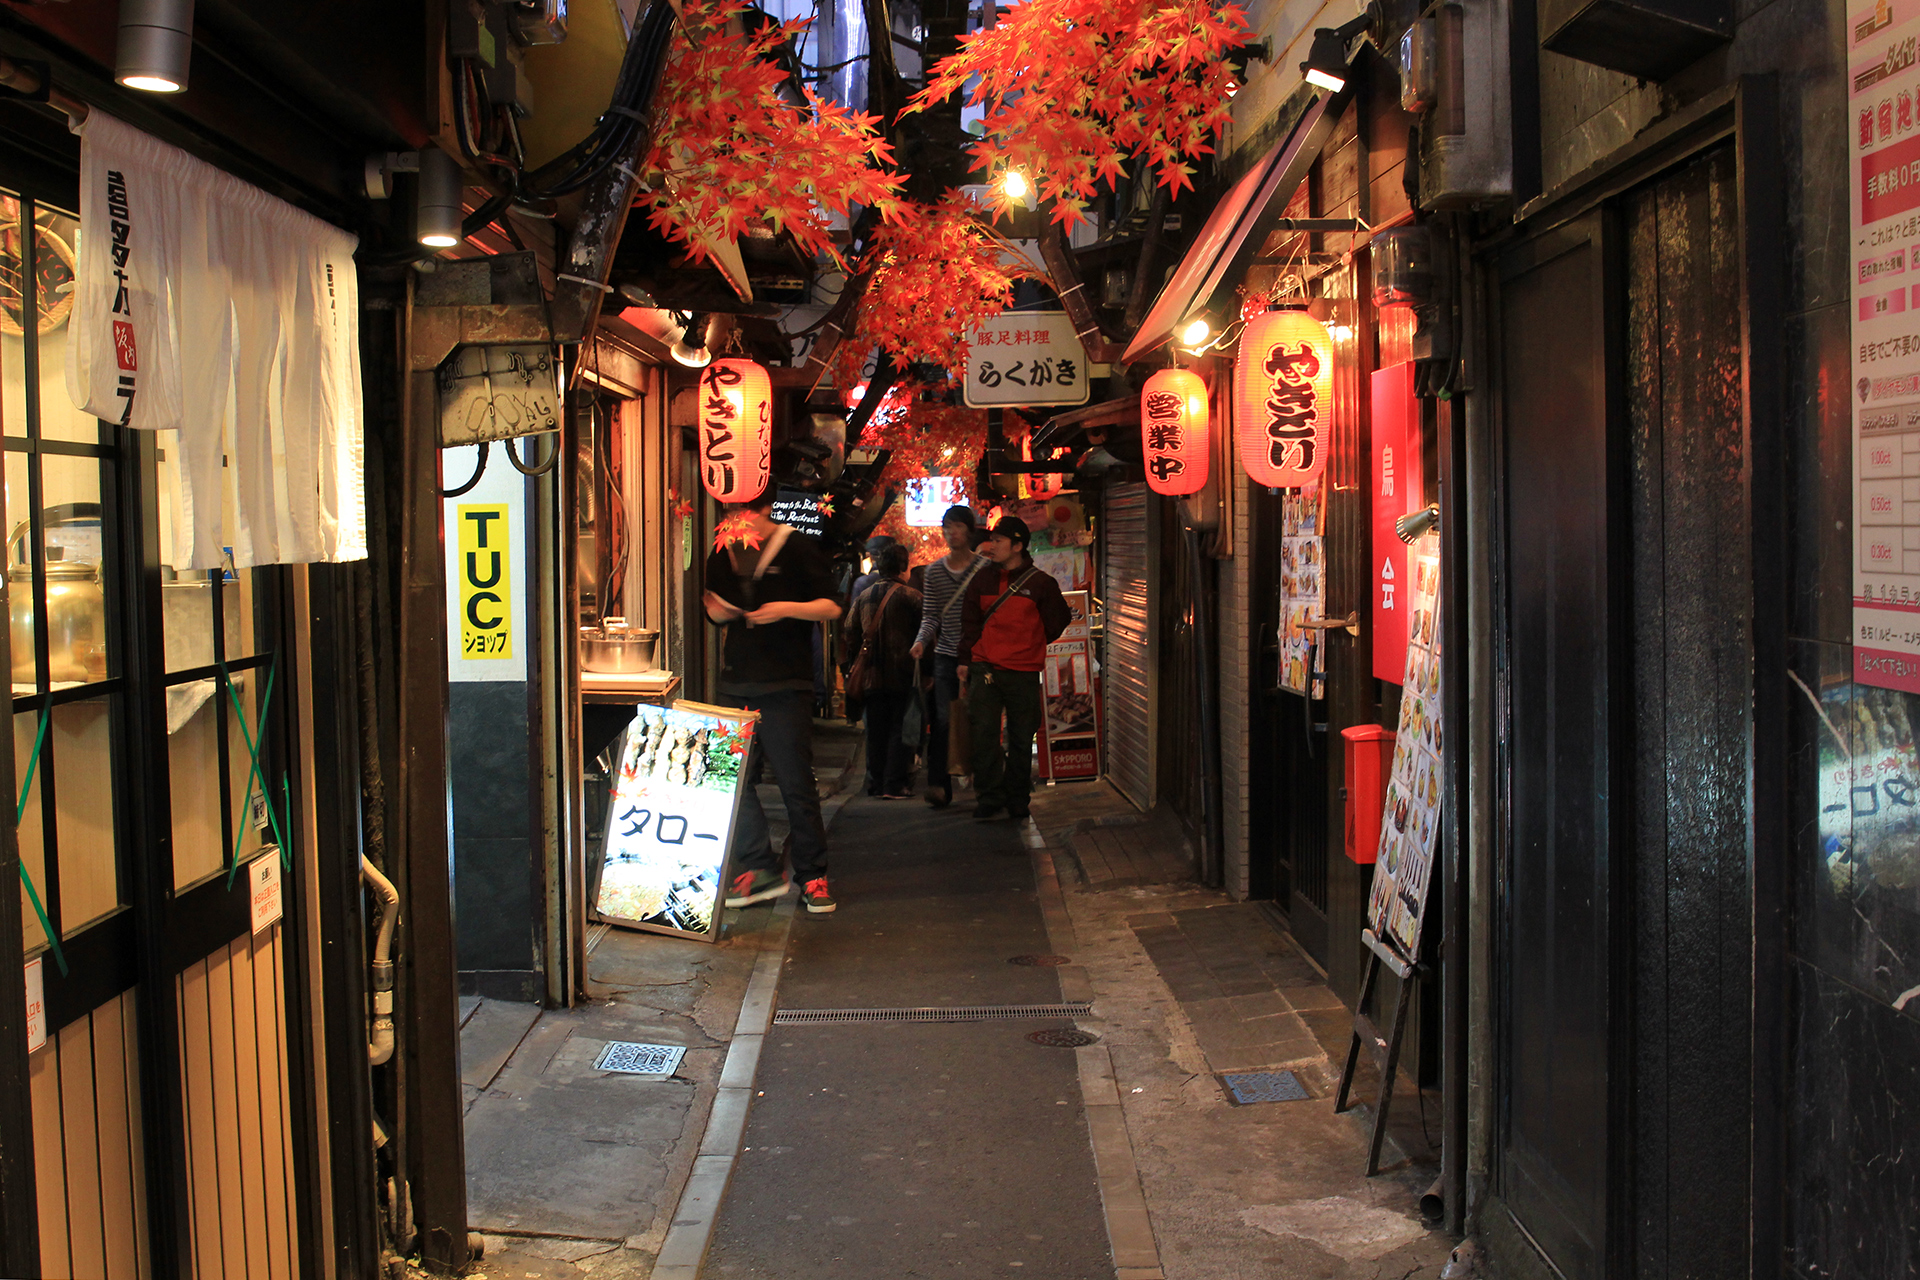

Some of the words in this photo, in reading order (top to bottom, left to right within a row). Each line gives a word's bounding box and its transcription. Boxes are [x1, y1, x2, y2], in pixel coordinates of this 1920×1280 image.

[977, 330, 1051, 347] 豚足料理
[978, 357, 1077, 388] らくがき
[703, 366, 742, 496] やきとり
[1147, 393, 1184, 481] 営業中
[1264, 344, 1320, 469] やきとり
[465, 512, 504, 630] TUC
[465, 630, 508, 654] ショップ
[619, 804, 719, 846] タロー
